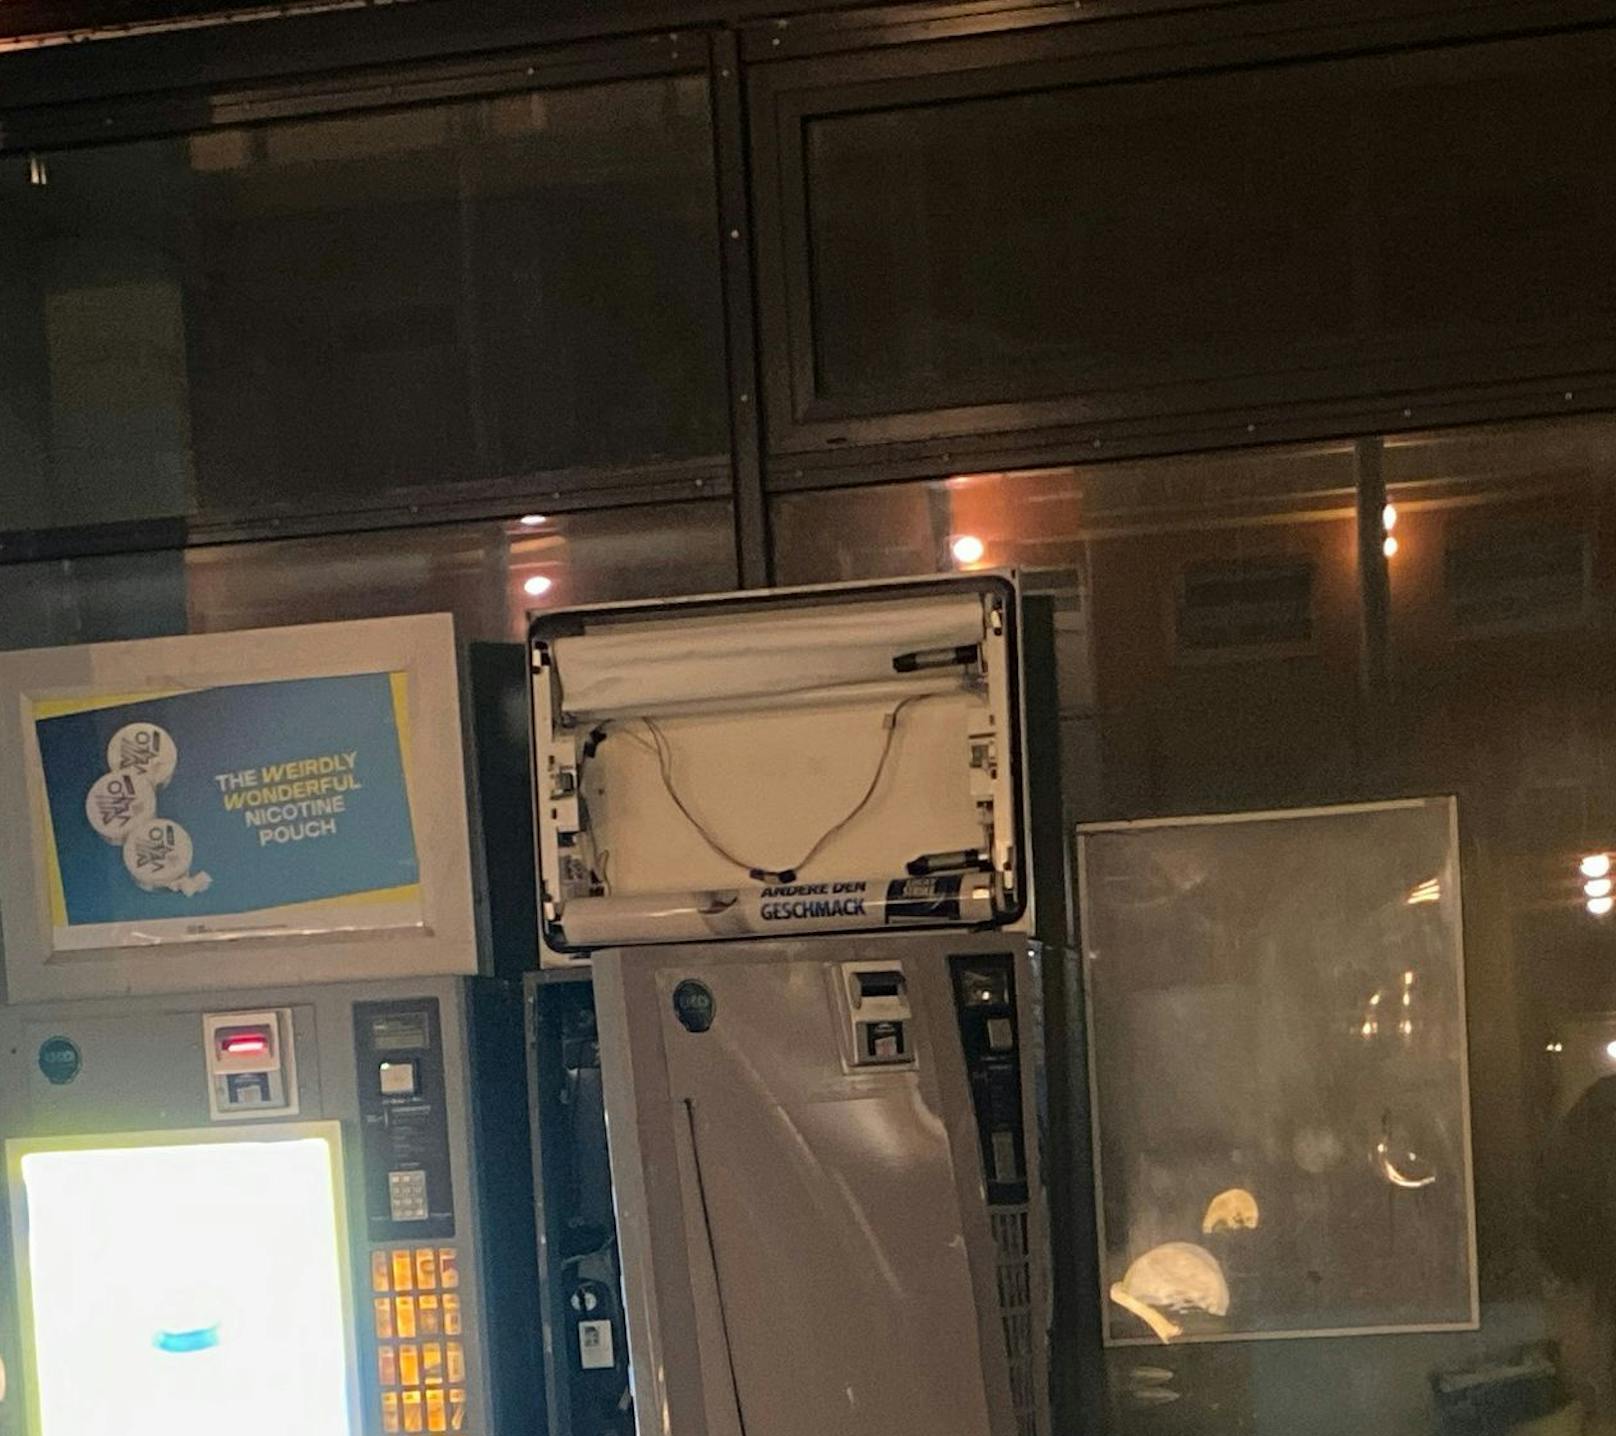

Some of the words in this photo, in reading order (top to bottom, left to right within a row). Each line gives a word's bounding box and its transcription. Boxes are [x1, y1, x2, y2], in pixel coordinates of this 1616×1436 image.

[215, 768, 258, 793] THE
[262, 751, 358, 783] WEIRDLY
[223, 774, 362, 812] WONDERFUL
[245, 795, 346, 828] NICOTINE
[260, 817, 337, 847] POUCH
[761, 899, 866, 921] GESCHMACK
